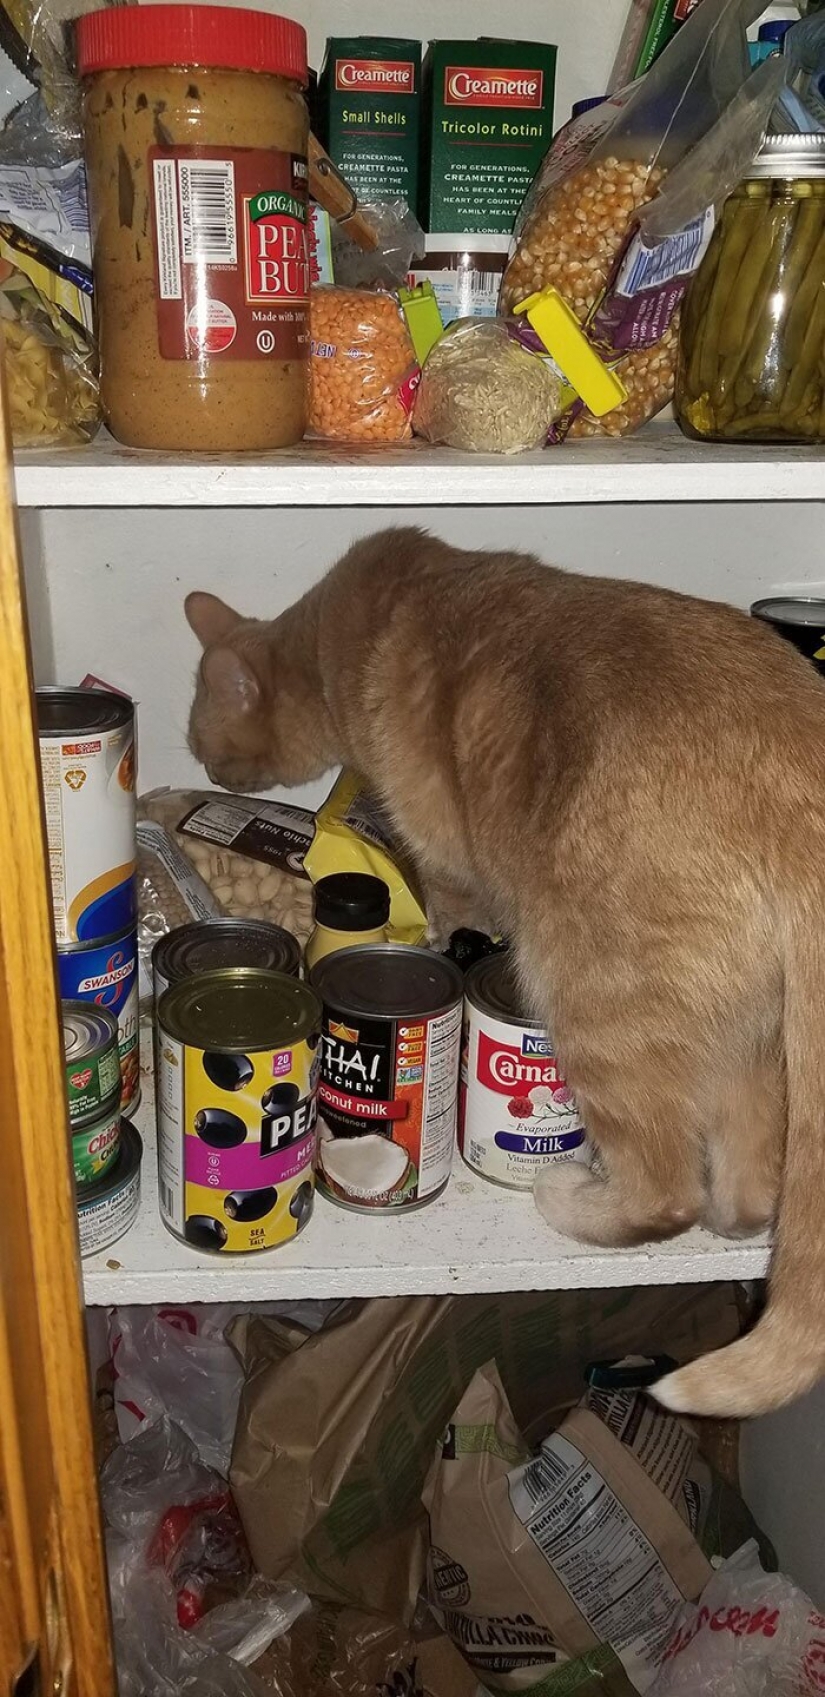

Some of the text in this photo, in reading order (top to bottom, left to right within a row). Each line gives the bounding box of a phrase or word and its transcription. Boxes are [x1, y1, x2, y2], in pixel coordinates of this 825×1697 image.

[341, 64, 409, 84] Creamette
[452, 72, 538, 100] Creamette
[342, 110, 406, 125] Small Shells
[442, 121, 543, 137] Tricolor Rotini
[357, 154, 405, 162] GENERATIONS,
[338, 163, 385, 173] CREAMETTE
[470, 164, 530, 173] GENERATIONS,
[181, 167, 189, 203] 555000
[444, 174, 505, 183] CREAMETTE
[183, 205, 191, 226] ART.
[184, 236, 193, 256] ITM.
[252, 311, 277, 321] Made
[279, 311, 294, 321] with
[254, 819, 281, 835] Nuts
[84, 963, 135, 990] SWANSON
[277, 1055, 290, 1065] 20
[356, 1101, 388, 1116] milk
[516, 1122, 571, 1135] Evaporated
[523, 1136, 564, 1153] Milk
[508, 1152, 575, 1165] Vitamin D Added
[506, 1164, 533, 1175] Leche
[78, 1202, 106, 1219] utrition
[250, 1228, 265, 1237] SEA
[529, 1496, 571, 1535] Nutrition
[565, 1471, 594, 1499] Facts
